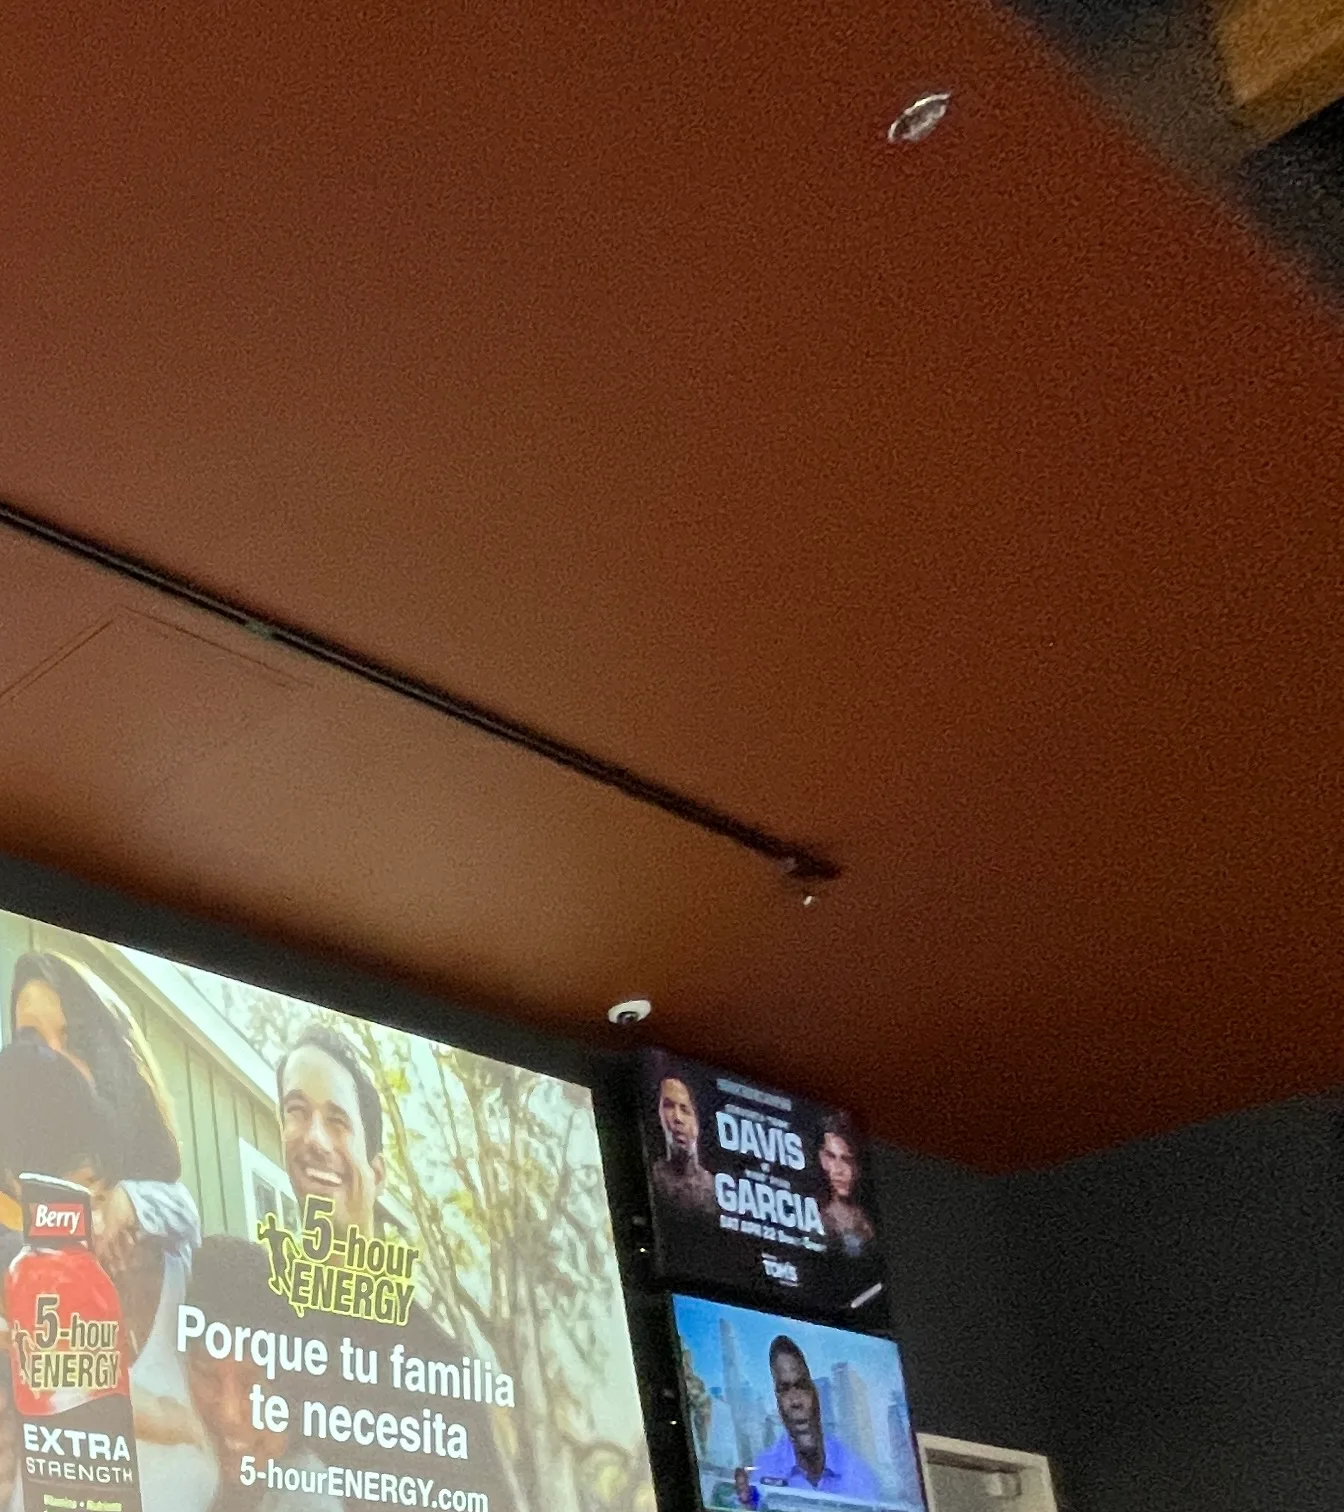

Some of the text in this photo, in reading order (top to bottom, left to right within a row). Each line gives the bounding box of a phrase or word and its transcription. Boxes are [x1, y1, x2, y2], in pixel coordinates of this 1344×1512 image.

[716, 1111, 806, 1171] DAVIS
[35, 1204, 81, 1235] Berry
[715, 1172, 826, 1236] GARCIA
[302, 1194, 419, 1280] 5-hour
[35, 1294, 118, 1350] 5-hour
[289, 1259, 416, 1326] ENERGY
[30, 1351, 120, 1390] ENERGY
[177, 1304, 516, 1408] Porque tu familia
[23, 1423, 131, 1461] EXTRA
[249, 1384, 469, 1460] te necesita
[25, 1456, 133, 1484] STRENGTH
